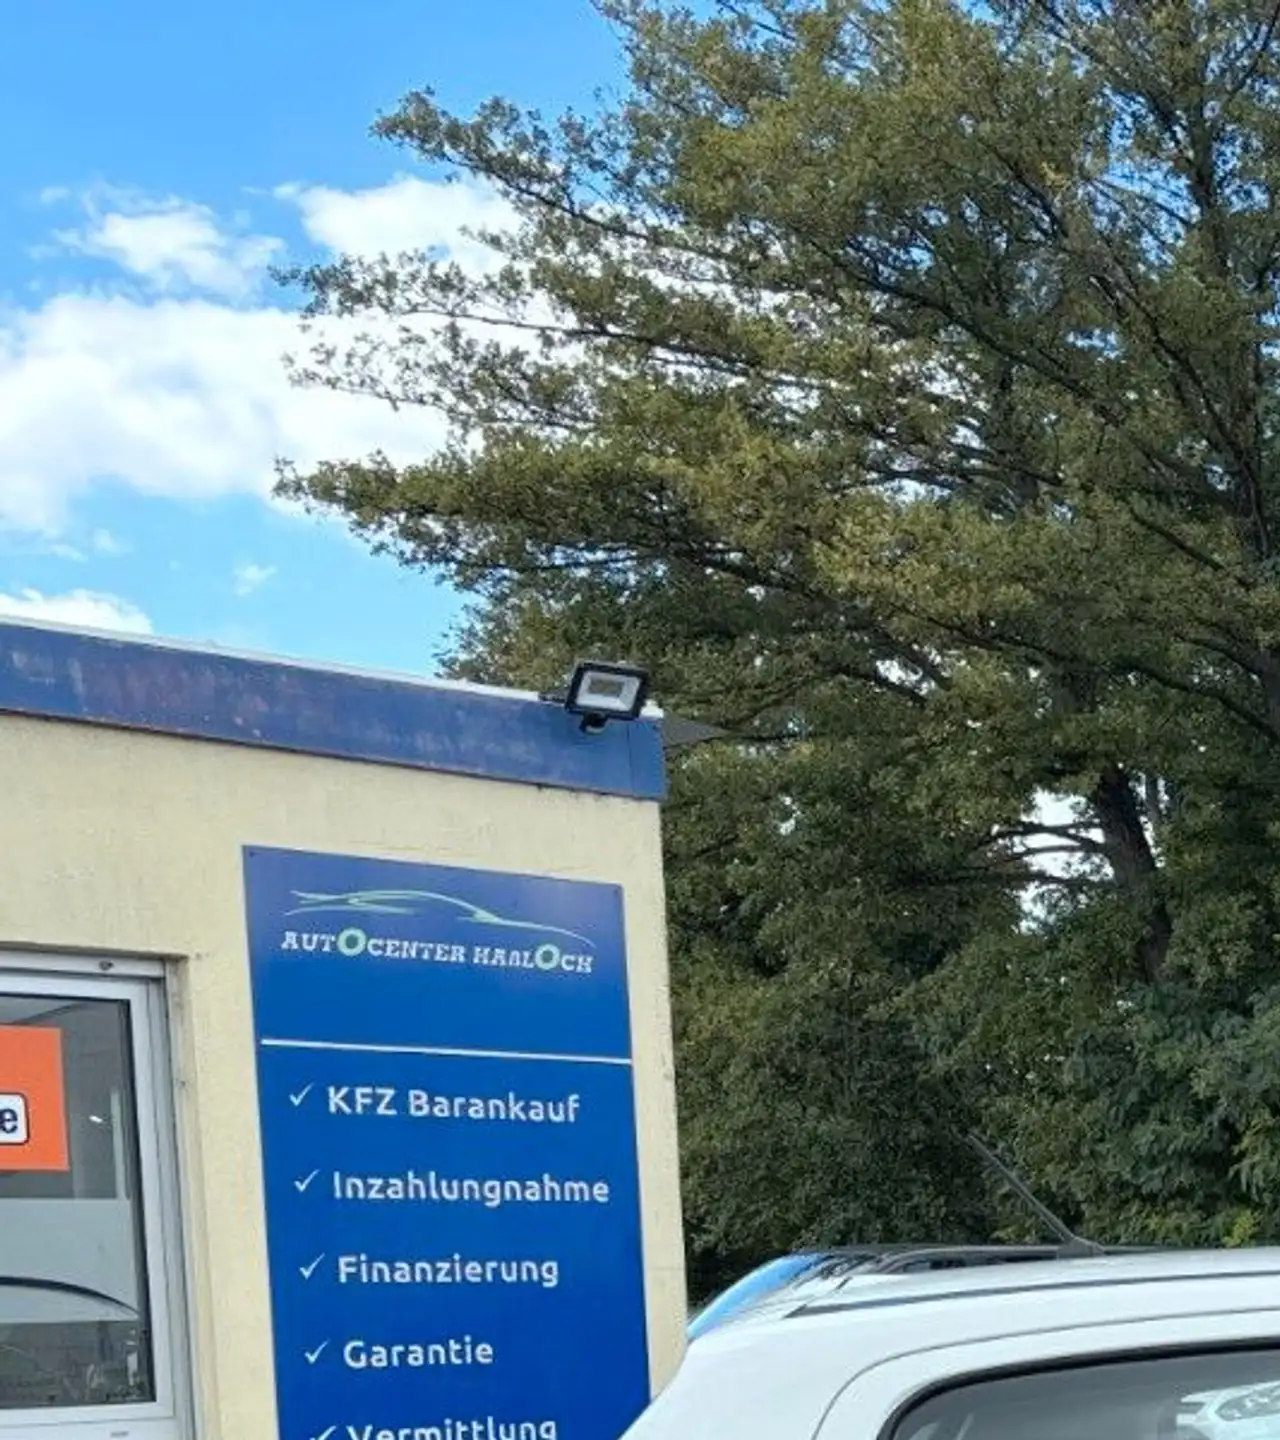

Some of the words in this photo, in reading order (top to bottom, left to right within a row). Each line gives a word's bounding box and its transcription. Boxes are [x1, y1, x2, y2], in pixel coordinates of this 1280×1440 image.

[281, 928, 466, 965] AUTOCENTER
[327, 1086, 397, 1116] KFZ
[407, 1089, 580, 1124] Barankauf
[332, 1170, 610, 1207] Inzahlungnahme
[337, 1253, 559, 1288] Finanzierung
[343, 1335, 494, 1369] Garantie
